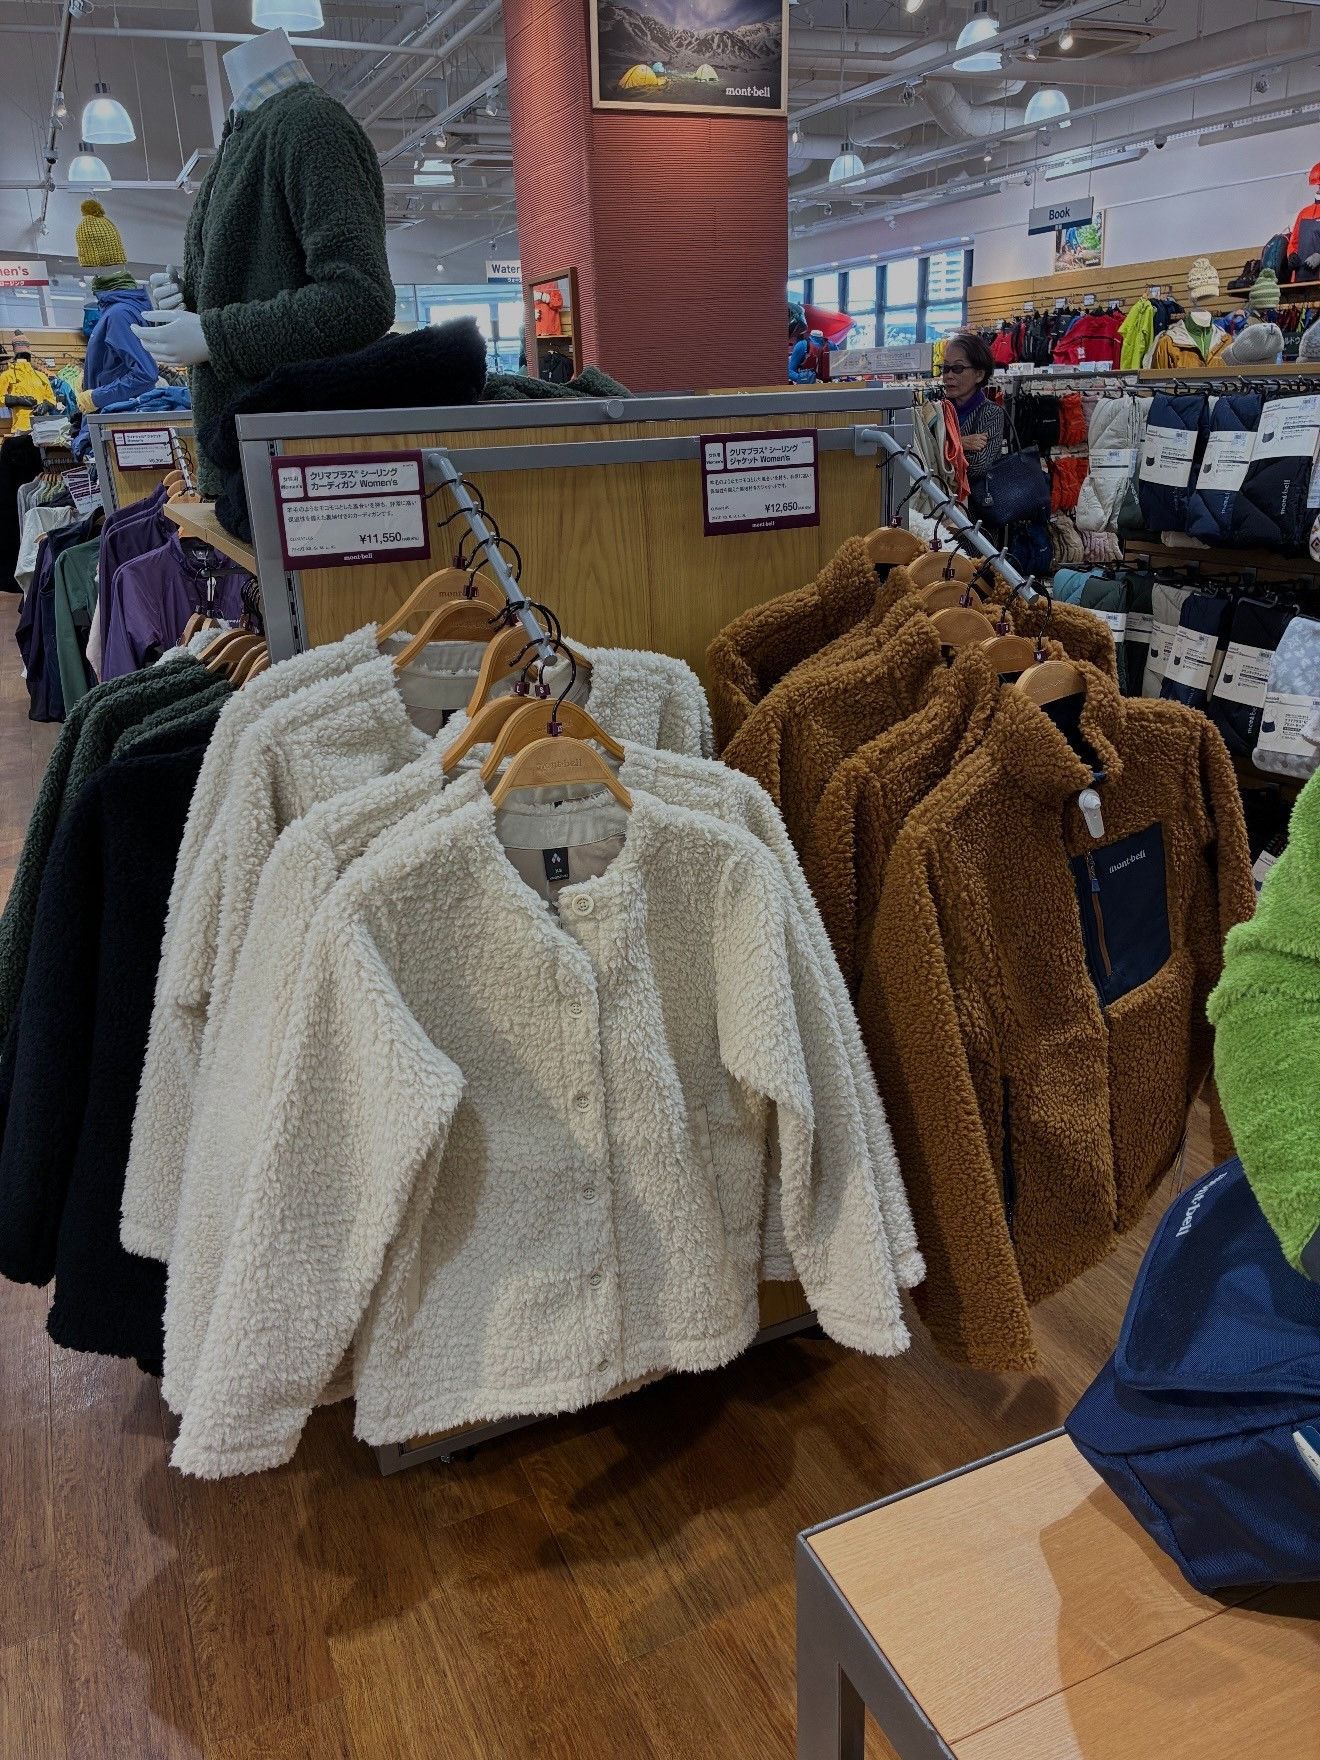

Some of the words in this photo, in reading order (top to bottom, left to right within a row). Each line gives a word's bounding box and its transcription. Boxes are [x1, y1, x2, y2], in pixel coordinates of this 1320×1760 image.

[1048, 207, 1071, 221] Book
[769, 444, 799, 454] シーリング
[729, 456, 759, 466] ジャケット
[760, 454, 791, 463] Women's
[360, 468, 398, 477] シーリング
[311, 480, 357, 491] カーディガン
[359, 478, 399, 488] Women's
[764, 502, 798, 513] ¥12,650
[359, 532, 402, 545] ¥11,550
